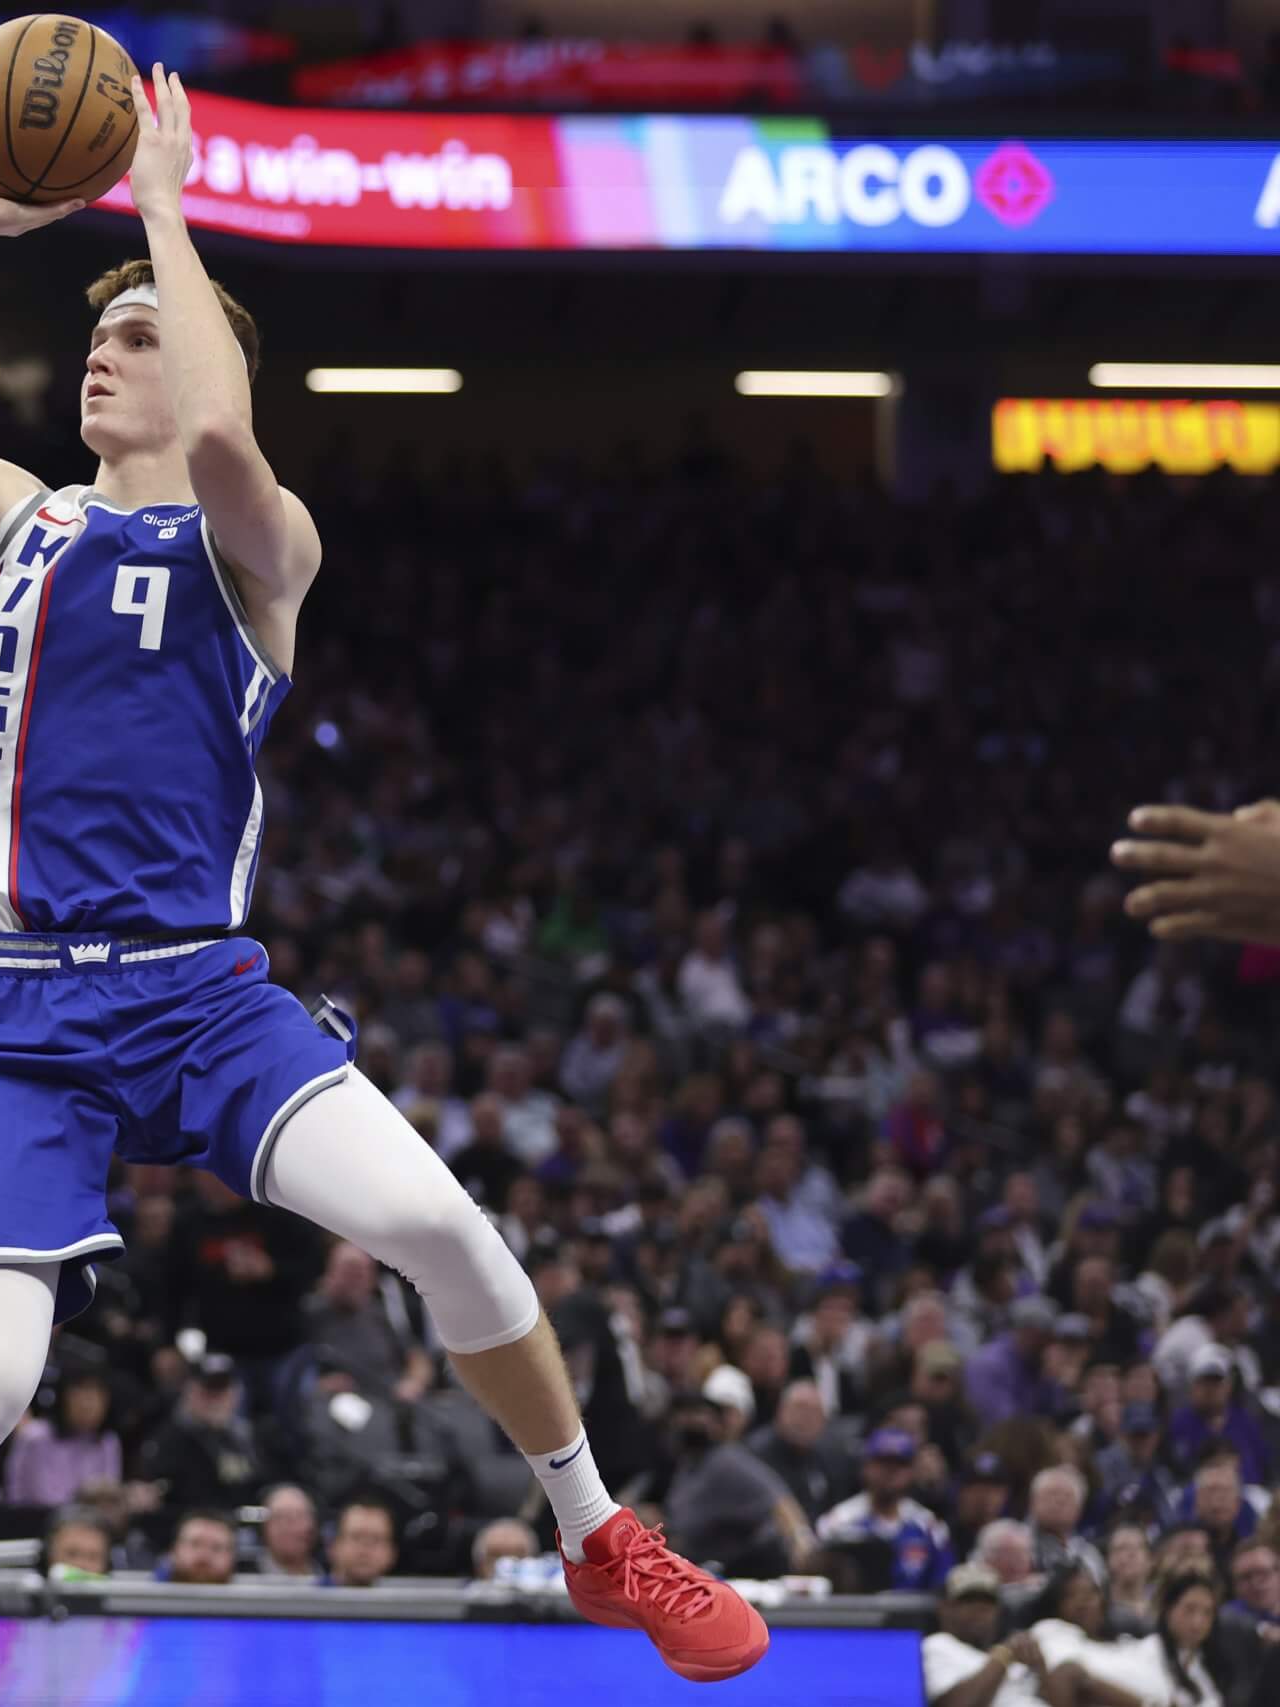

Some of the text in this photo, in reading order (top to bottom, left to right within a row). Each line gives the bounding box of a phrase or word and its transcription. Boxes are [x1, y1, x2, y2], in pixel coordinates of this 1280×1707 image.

[19, 21, 80, 130] Wilson
[244, 134, 513, 211] win-win
[718, 144, 970, 228] ARCO
[143, 506, 200, 527] dialpad
[111, 564, 171, 651] 9
